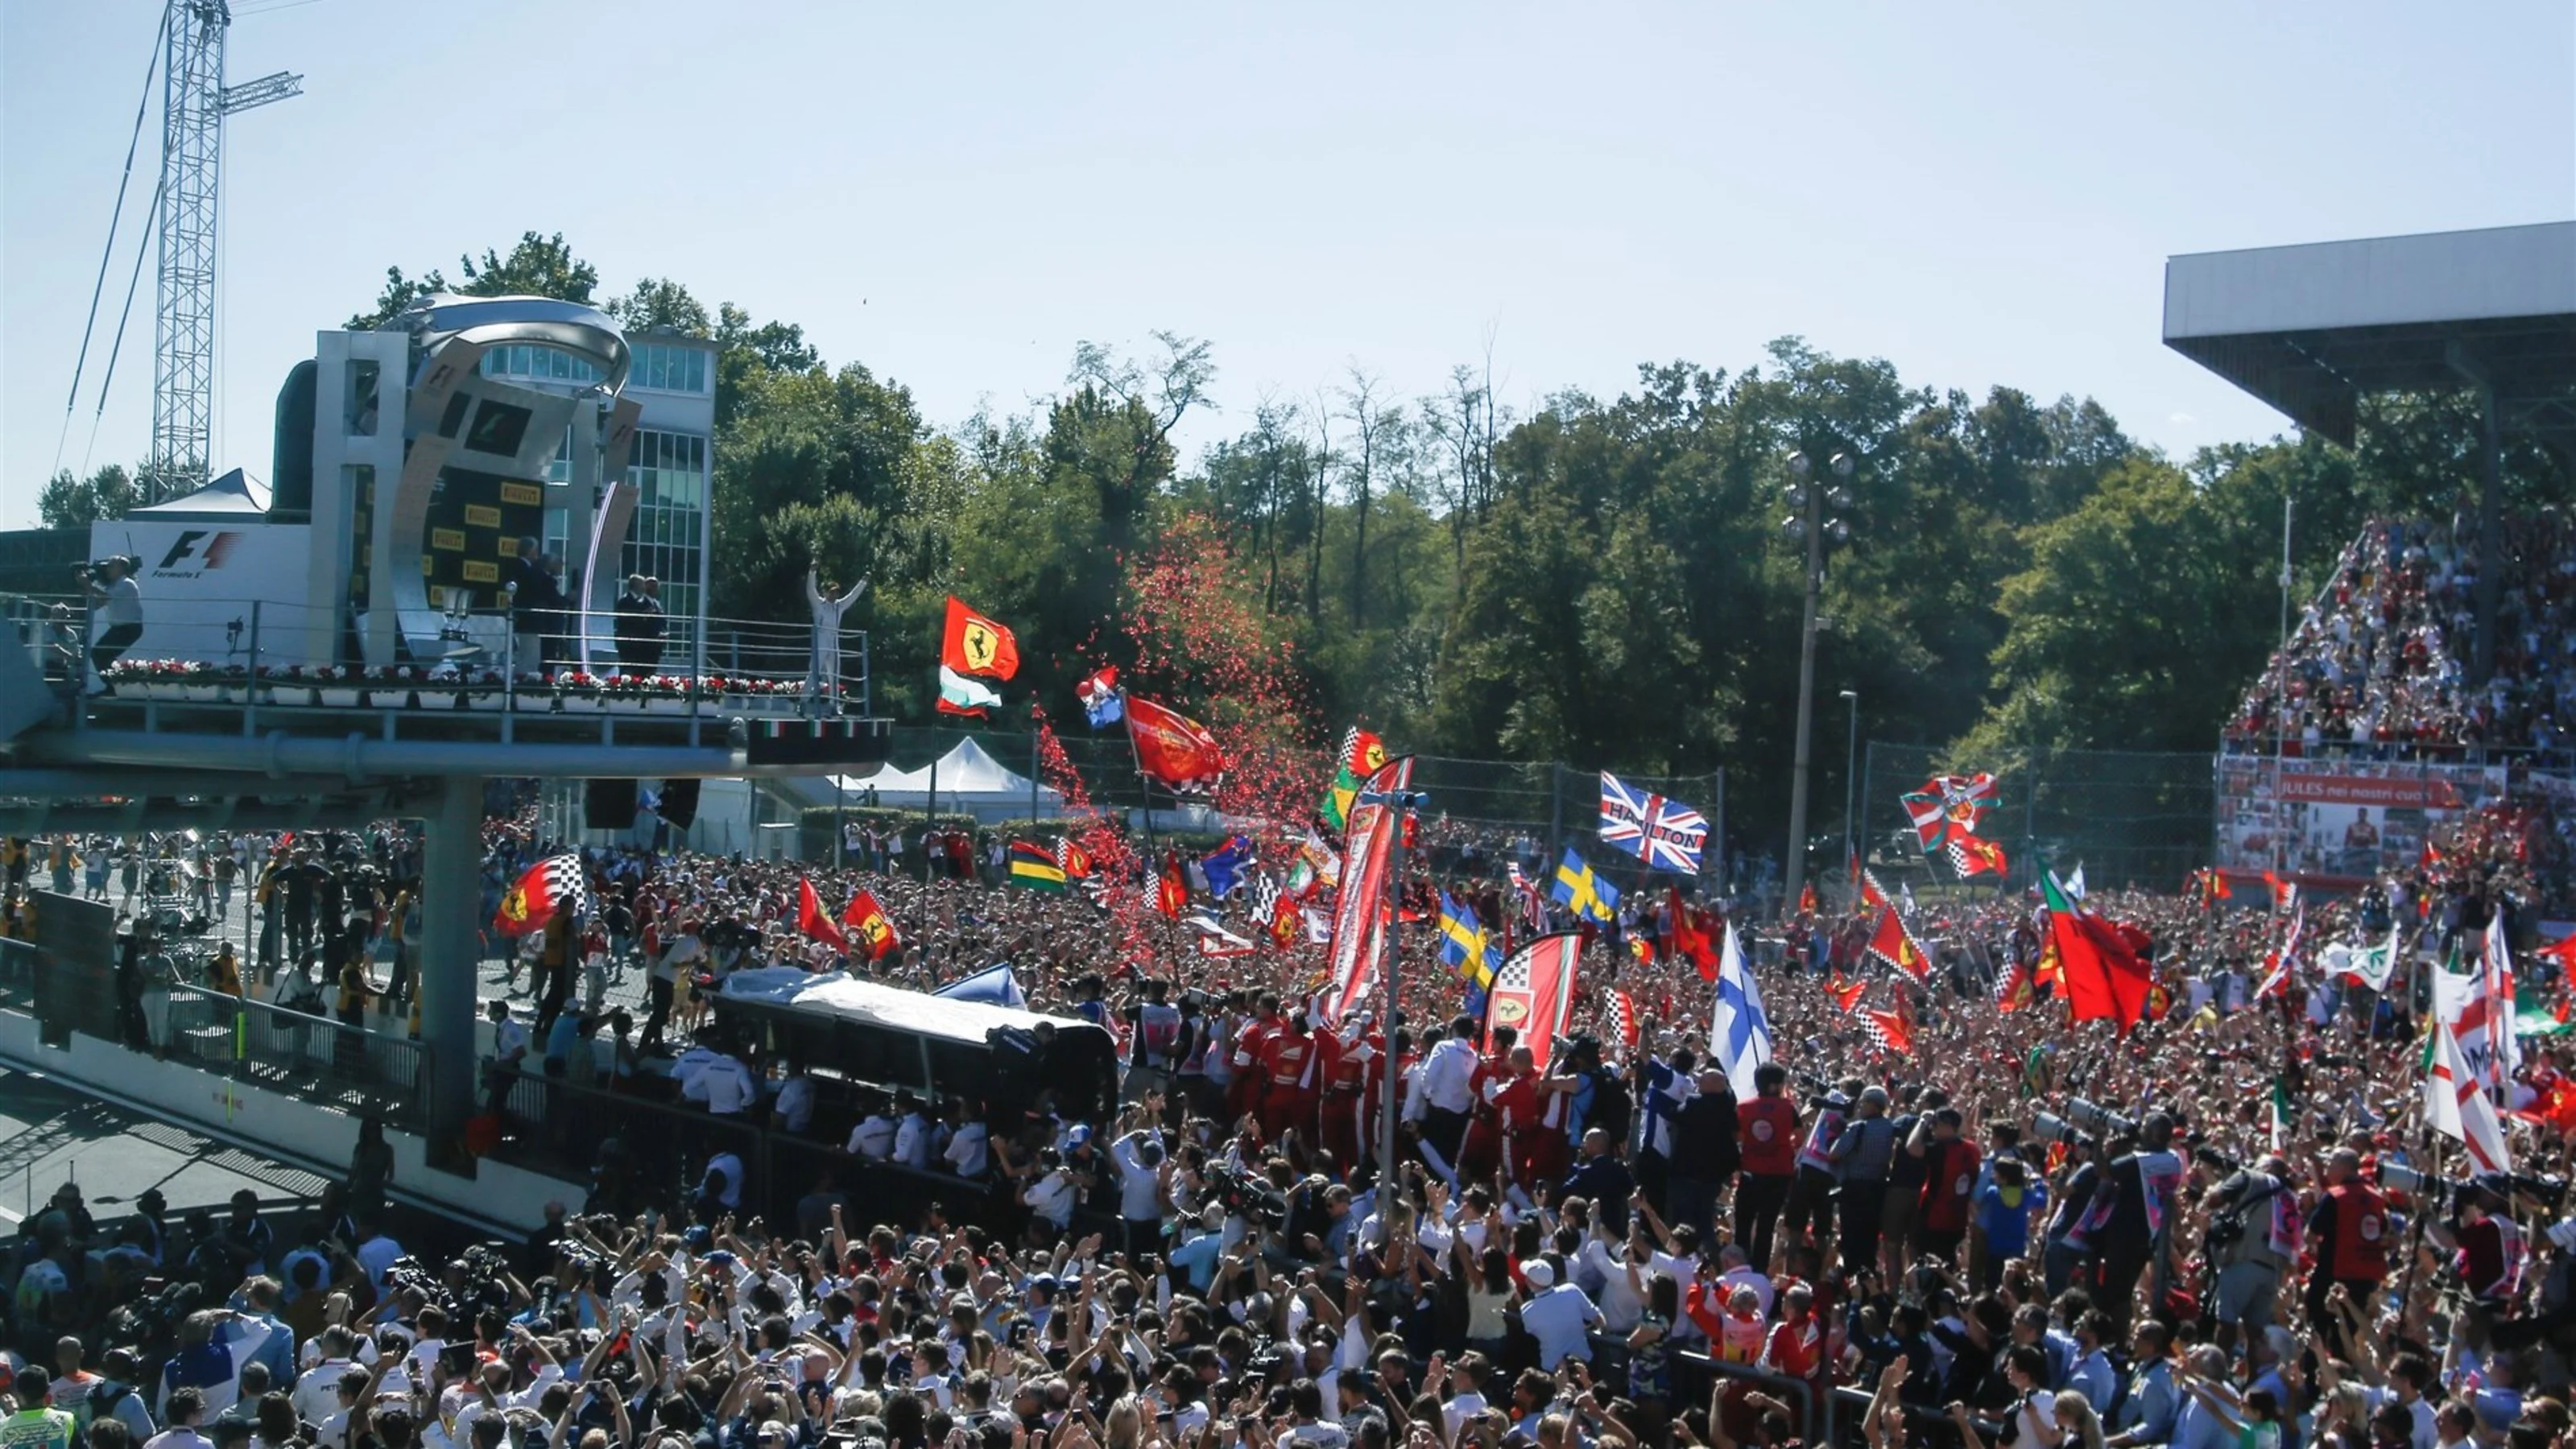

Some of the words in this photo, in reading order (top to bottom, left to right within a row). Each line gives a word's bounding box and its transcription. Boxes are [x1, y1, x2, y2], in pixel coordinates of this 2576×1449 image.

[158, 530, 246, 569] F1
[2283, 782, 2324, 795] JULES
[2327, 786, 2347, 798] nei
[2351, 787, 2392, 800] nostri
[2396, 790, 2433, 801] cuoi
